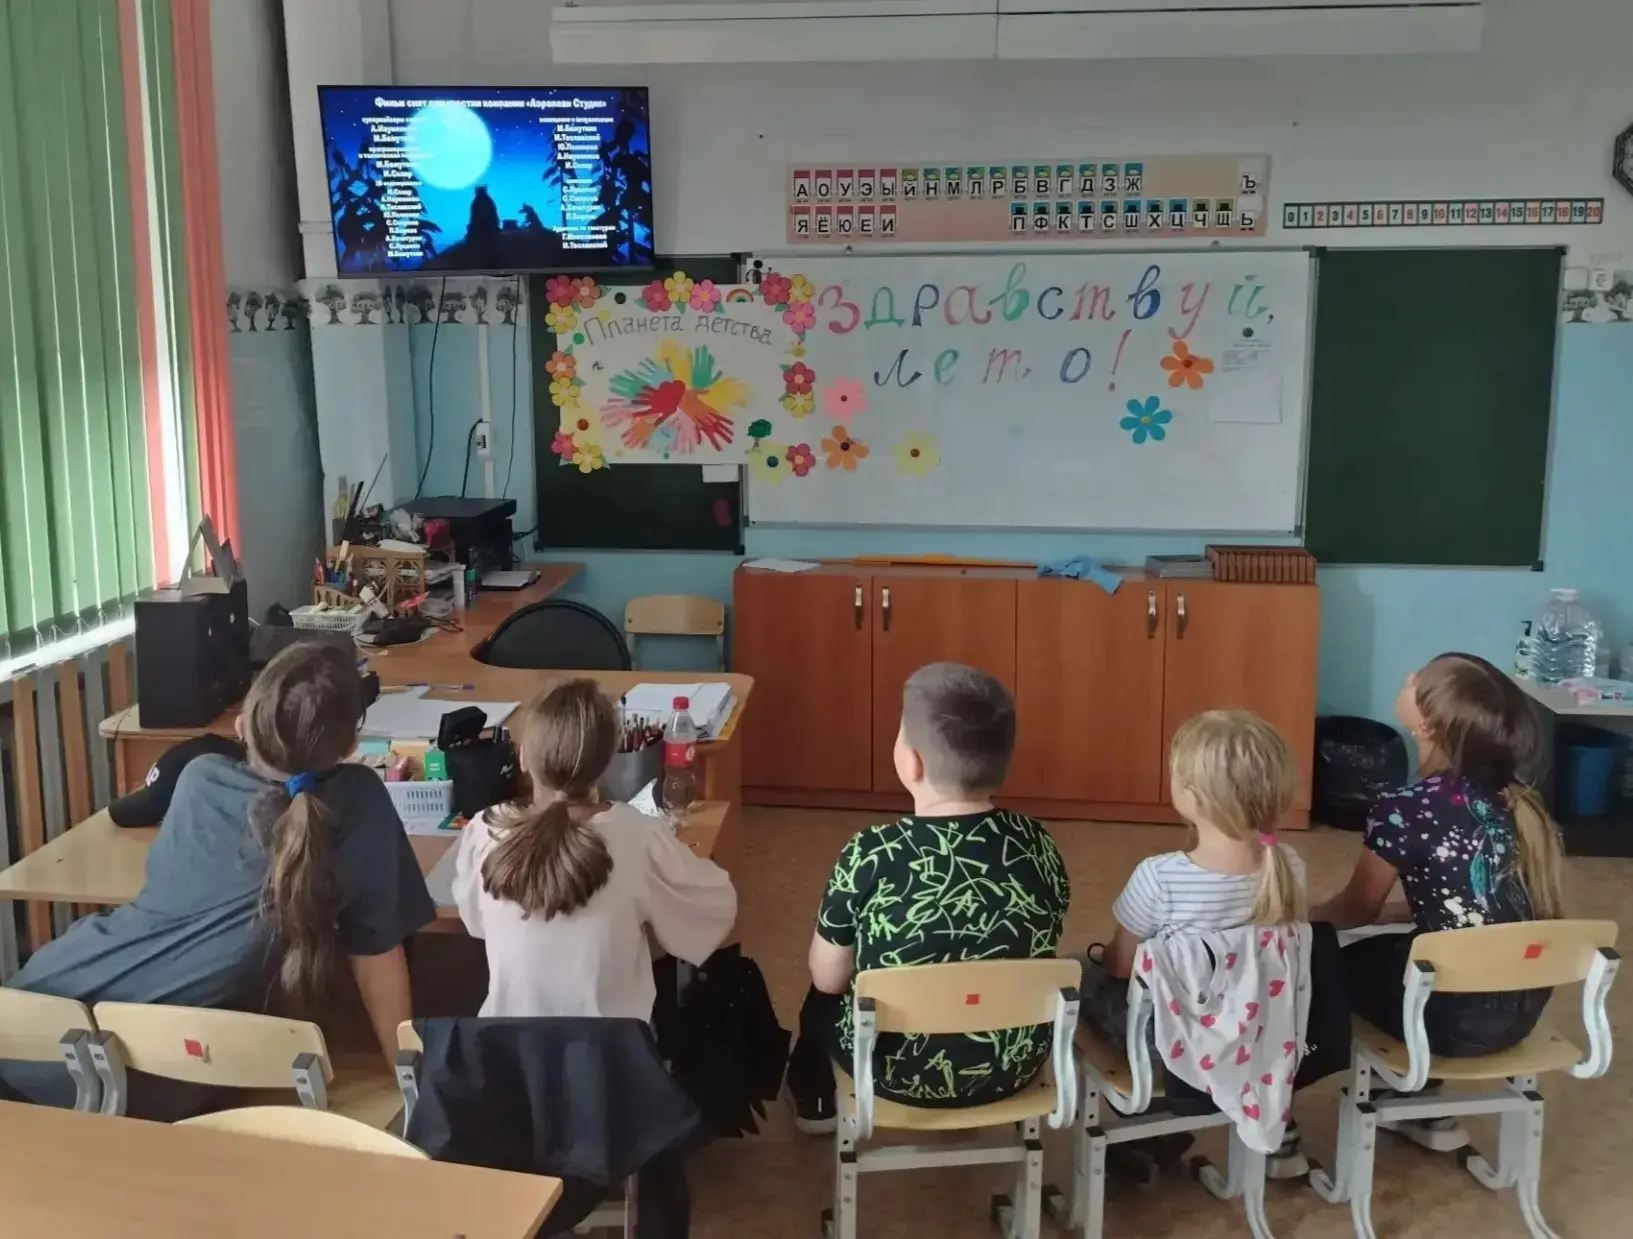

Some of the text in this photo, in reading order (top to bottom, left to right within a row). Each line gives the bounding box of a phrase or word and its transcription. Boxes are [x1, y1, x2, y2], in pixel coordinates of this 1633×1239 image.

[797, 183, 808, 196] А
[818, 183, 830, 197] О
[840, 183, 852, 197] У
[862, 182, 873, 196] Э
[883, 181, 895, 196] Ы
[926, 181, 938, 195] Н
[948, 181, 960, 195] М
[970, 181, 982, 194] Л
[993, 181, 1004, 194] Р
[1015, 180, 1026, 193] Б
[1037, 180, 1048, 193] В
[1060, 179, 1070, 192] Г
[1082, 179, 1094, 192] Д
[1104, 178, 1115, 191] З
[1126, 178, 1140, 191] Ж
[1242, 175, 1256, 189] Ъ
[797, 213, 1254, 233] Я Ё Ю Е И П Ф К Т С Ш Х Ц Ч Щ Ь
[1287, 206, 1599, 222] 0 1 2 3 4 5 6 7 8 9 10 11 12 13 14 15 16 17 18 19 20
[817, 262, 1275, 340] Здравствуй,
[583, 315, 774, 346] Планета детства
